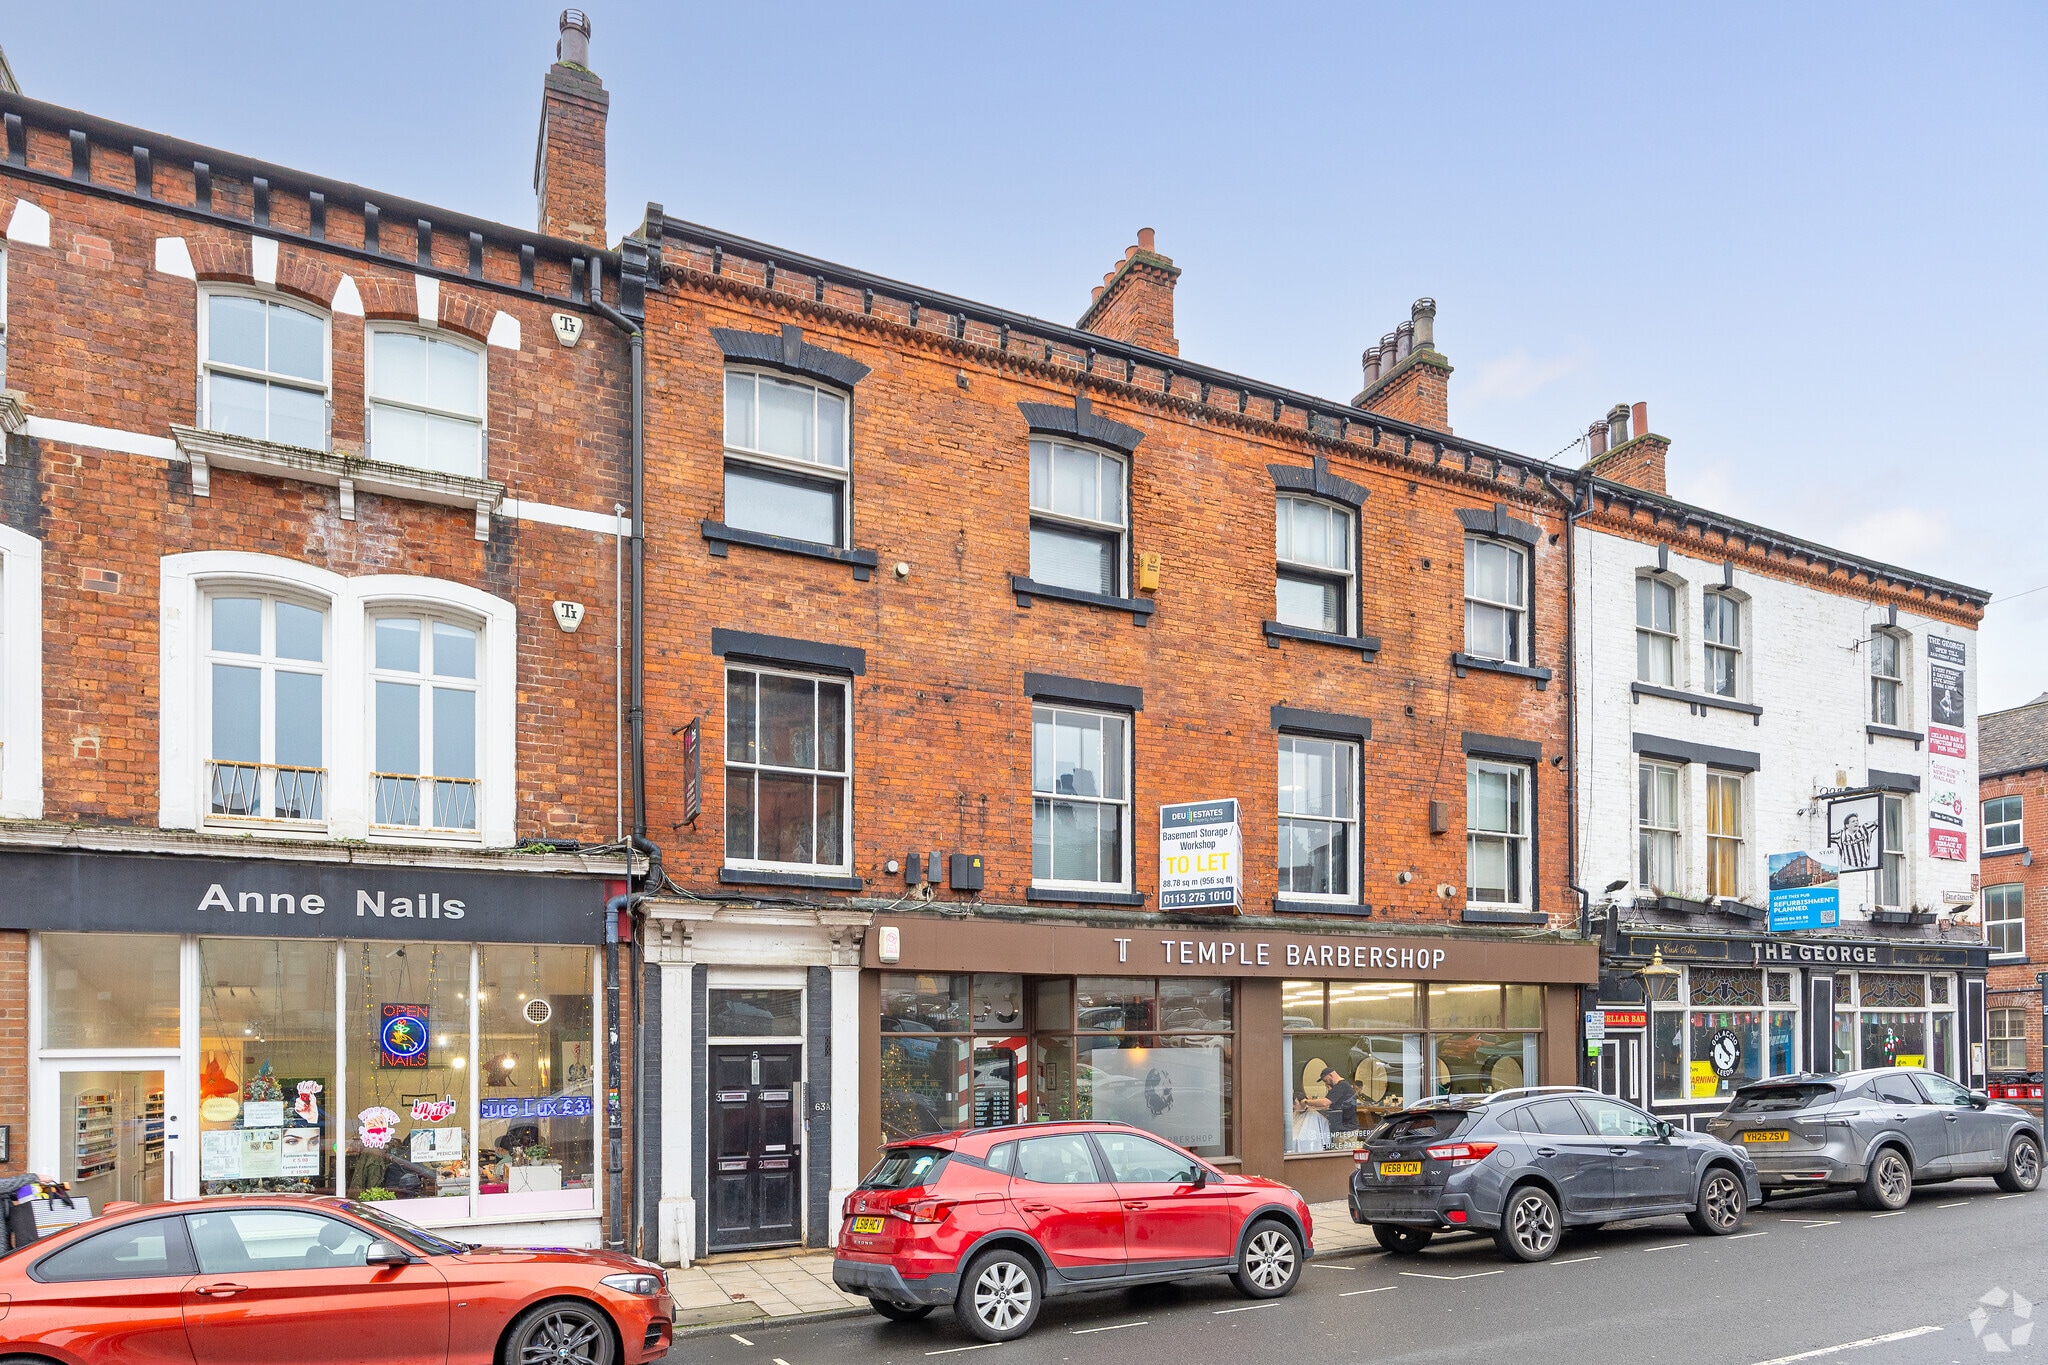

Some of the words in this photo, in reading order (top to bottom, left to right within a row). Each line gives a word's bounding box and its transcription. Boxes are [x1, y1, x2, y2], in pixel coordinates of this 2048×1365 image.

[1928, 636, 1941, 646] THE
[1941, 638, 1965, 651] GEORGE
[1933, 666, 1945, 674] EVERY
[1931, 732, 1949, 741] CELLAR
[1950, 735, 1960, 743] BAR
[1930, 738, 1953, 747] FUNCTION
[1953, 740, 1965, 750] ROOM
[1932, 763, 1946, 772] LIGHT
[1947, 766, 1960, 775] LUNCH
[1932, 768, 1946, 777] MENU
[1932, 774, 1956, 784] AVAILABLE
[1193, 808, 1223, 819] ESTATES
[1162, 830, 1198, 841] Basement
[1200, 828, 1228, 839] Storage
[1938, 834, 1959, 843] OUTDOOR
[1179, 840, 1216, 851] Workshop
[1934, 840, 1956, 850] TERRACE
[1166, 855, 1190, 875] TO
[1197, 852, 1231, 873] LET
[1162, 879, 1181, 888] 88.78
[1199, 877, 1215, 887] (956
[1216, 877, 1225, 885] sq
[197, 883, 325, 915] Anne
[356, 889, 466, 920] Nails
[1163, 894, 1186, 904] 0113
[1188, 892, 1206, 903] 275
[1208, 890, 1232, 901] 1010
[1773, 896, 1835, 907] REFURBISHMENT
[1773, 905, 1809, 914] PLANNED.
[1662, 942, 1679, 954] Cask
[1680, 943, 1697, 955] Ales
[1751, 942, 1792, 961] THE
[1799, 946, 1877, 963] GEORGE
[1161, 940, 1270, 966] TEMPLE
[1286, 944, 1446, 970] BARBERSHOP
[383, 1005, 428, 1018] OPEN
[1631, 1015, 1646, 1023] BAR
[1711, 1030, 1738, 1046] GOLACCIO
[381, 1052, 427, 1067] NAILS
[752, 1051, 759, 1060] 5
[1716, 1068, 1734, 1077] LEEDS
[715, 1093, 722, 1102] 3
[758, 1092, 764, 1101] 4
[418, 1102, 450, 1117] Nails
[521, 1099, 557, 1117] Lux
[814, 1102, 831, 1111] 63A
[1746, 1133, 1768, 1141] YH25
[1768, 1132, 1785, 1140] ZSV
[718, 1161, 722, 1170] 1
[758, 1160, 764, 1169] 2
[1383, 1164, 1401, 1173] VE68
[1403, 1163, 1418, 1172] YCN
